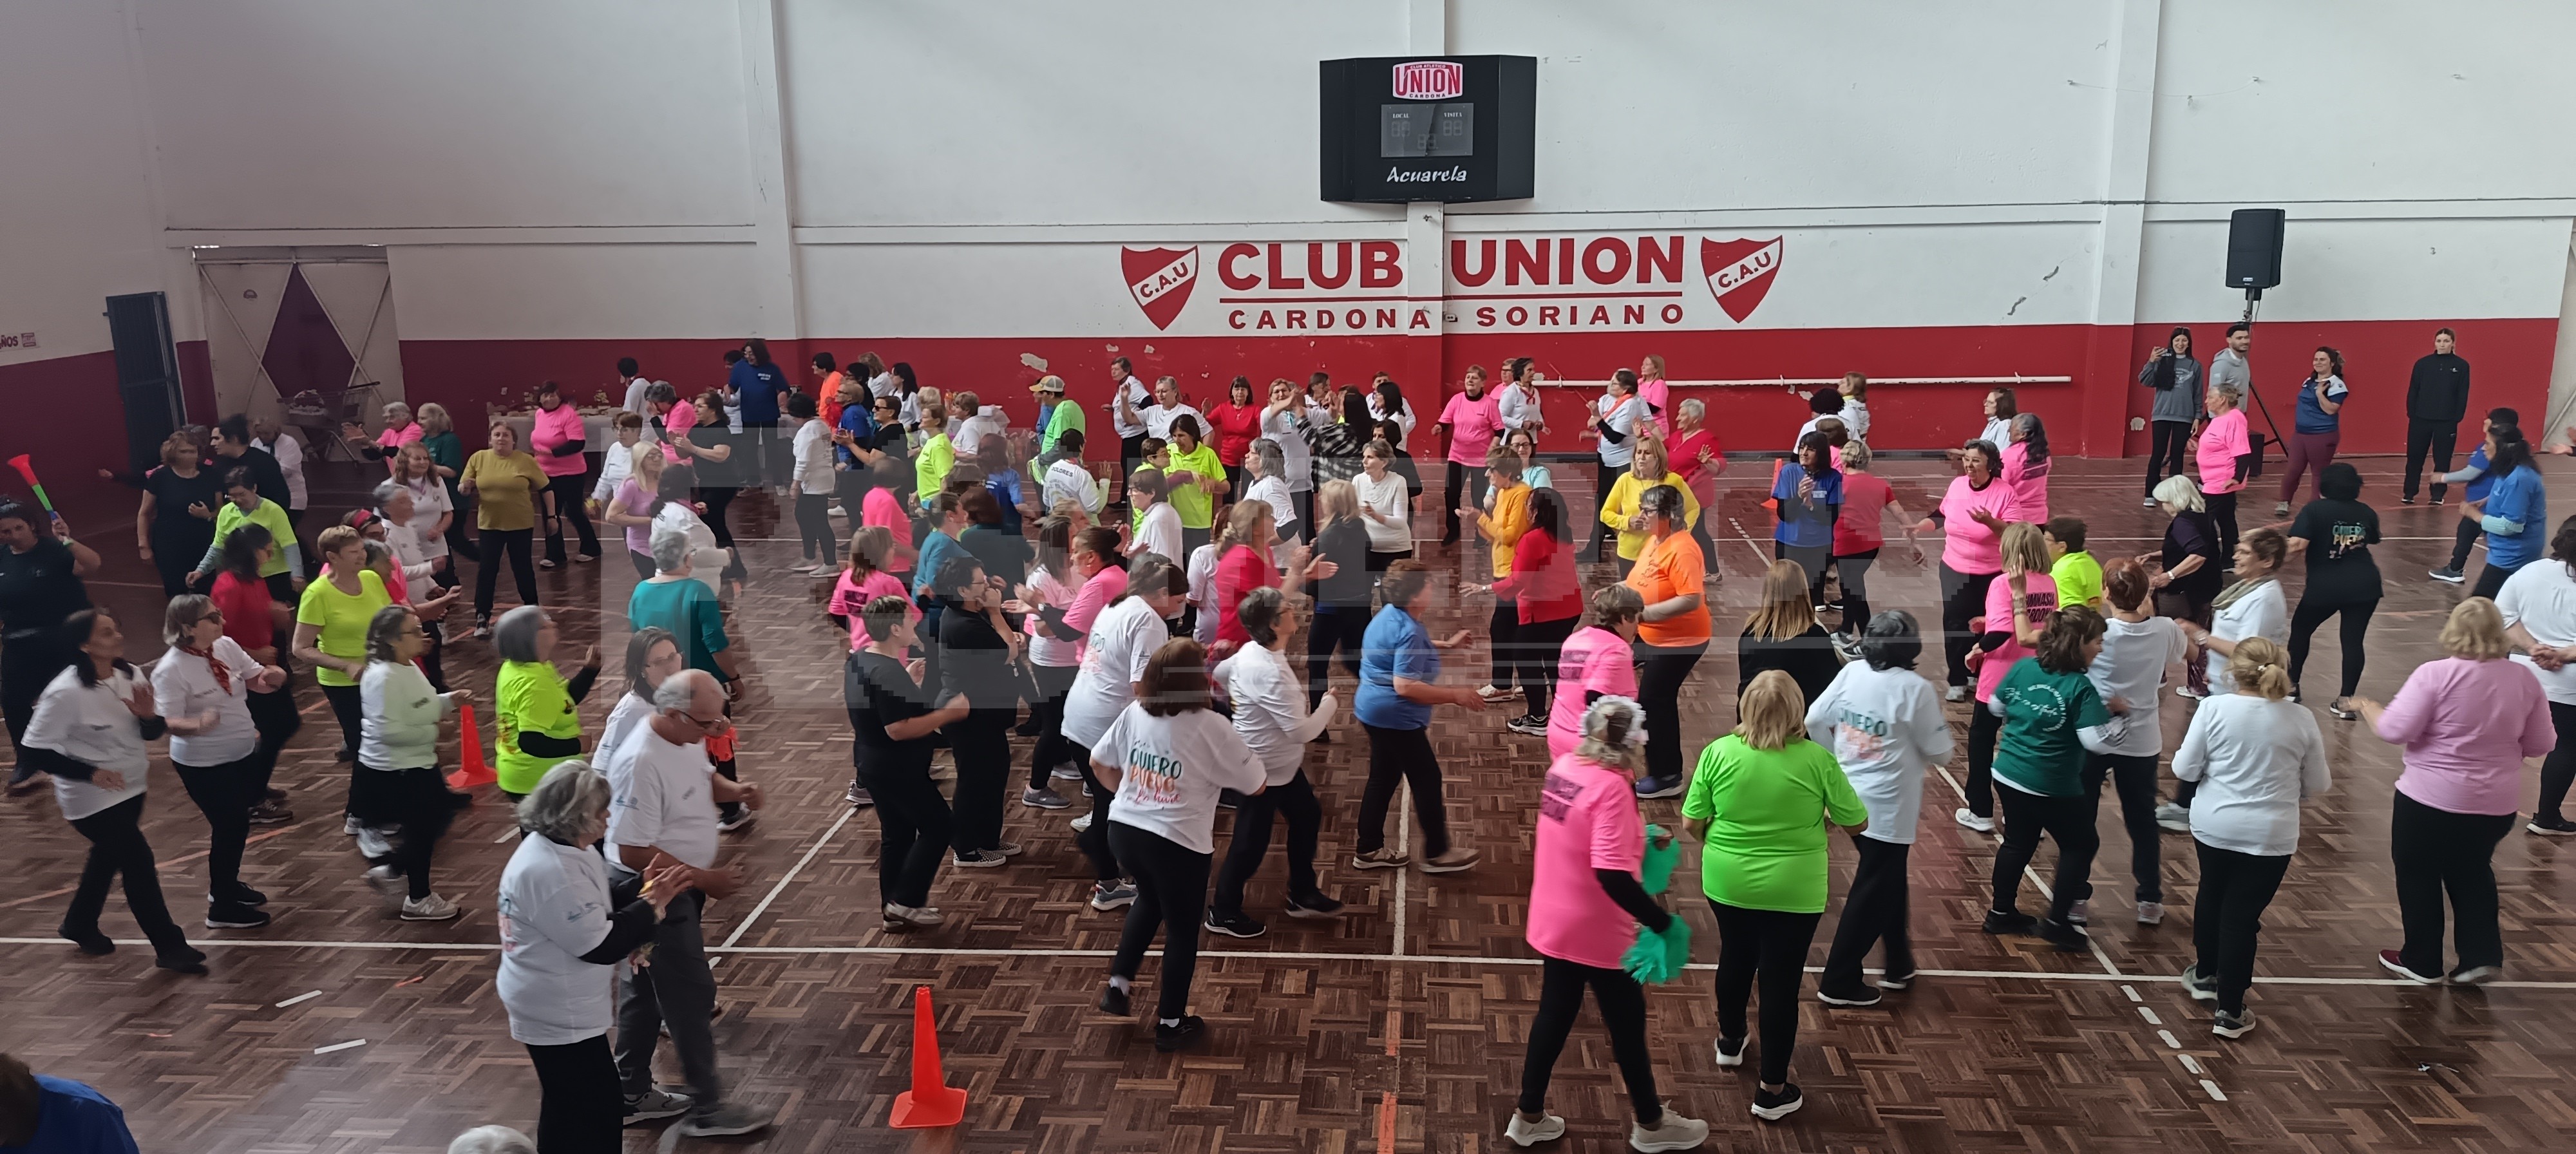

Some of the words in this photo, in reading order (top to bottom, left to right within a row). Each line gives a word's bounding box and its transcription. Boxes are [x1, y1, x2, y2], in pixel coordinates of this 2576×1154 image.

[1395, 64, 1460, 96] UNION
[1387, 166, 1467, 182] Acuarela
[1218, 241, 1403, 290] CLUB
[1451, 236, 1684, 287] UNION
[1229, 309, 1430, 330] CARDONA
[1476, 304, 1683, 326] SORIANO
[0, 334, 18, 348] ÑOS
[1130, 748, 1182, 780] QUIERO
